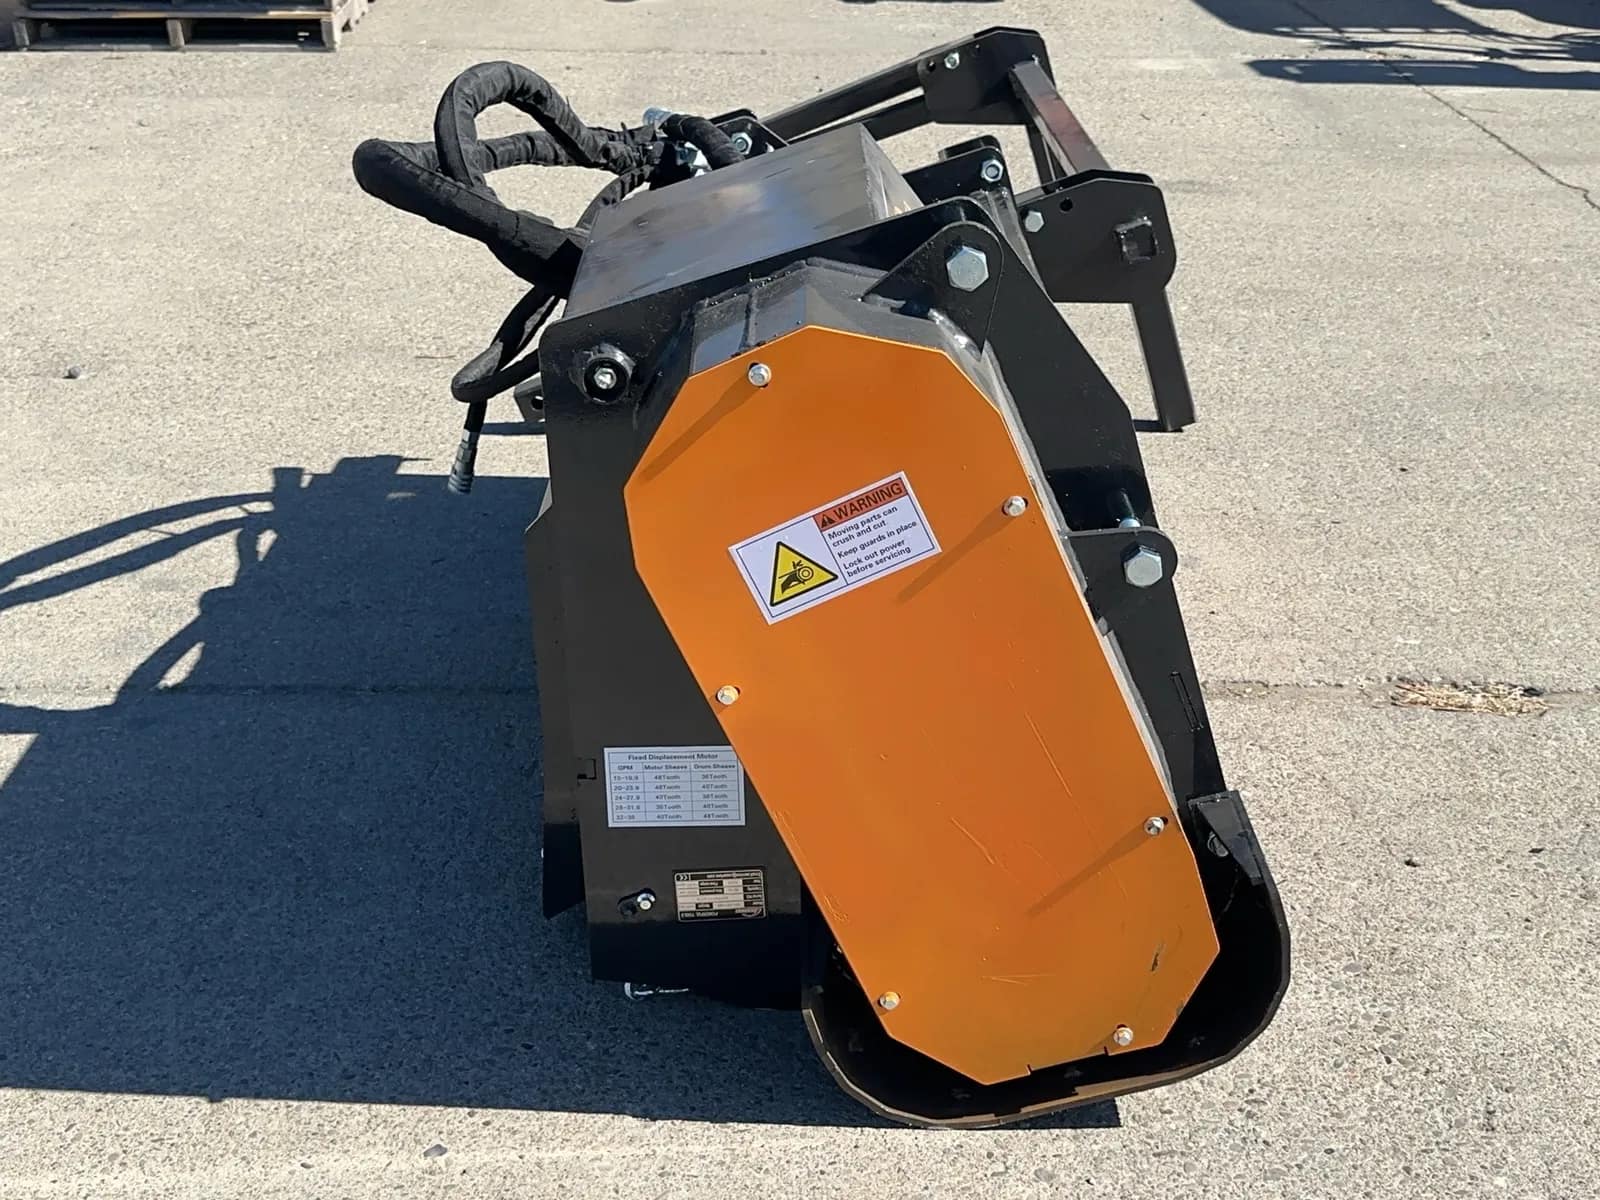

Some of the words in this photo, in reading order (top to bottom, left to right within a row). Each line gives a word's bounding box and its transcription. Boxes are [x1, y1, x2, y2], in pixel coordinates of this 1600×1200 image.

[834, 483, 902, 520] WARNING
[828, 523, 859, 540] Moving
[860, 513, 882, 529] parts
[882, 506, 898, 516] can
[832, 534, 855, 547] crush
[856, 526, 872, 537] and
[873, 520, 886, 530] cut
[837, 546, 858, 559] Keep
[859, 534, 886, 551] guards
[887, 530, 895, 538] in
[896, 521, 917, 536] place
[843, 558, 862, 570] Lock
[864, 551, 878, 562] out
[880, 540, 906, 556] power
[846, 562, 874, 577] before
[875, 546, 912, 566] servicing
